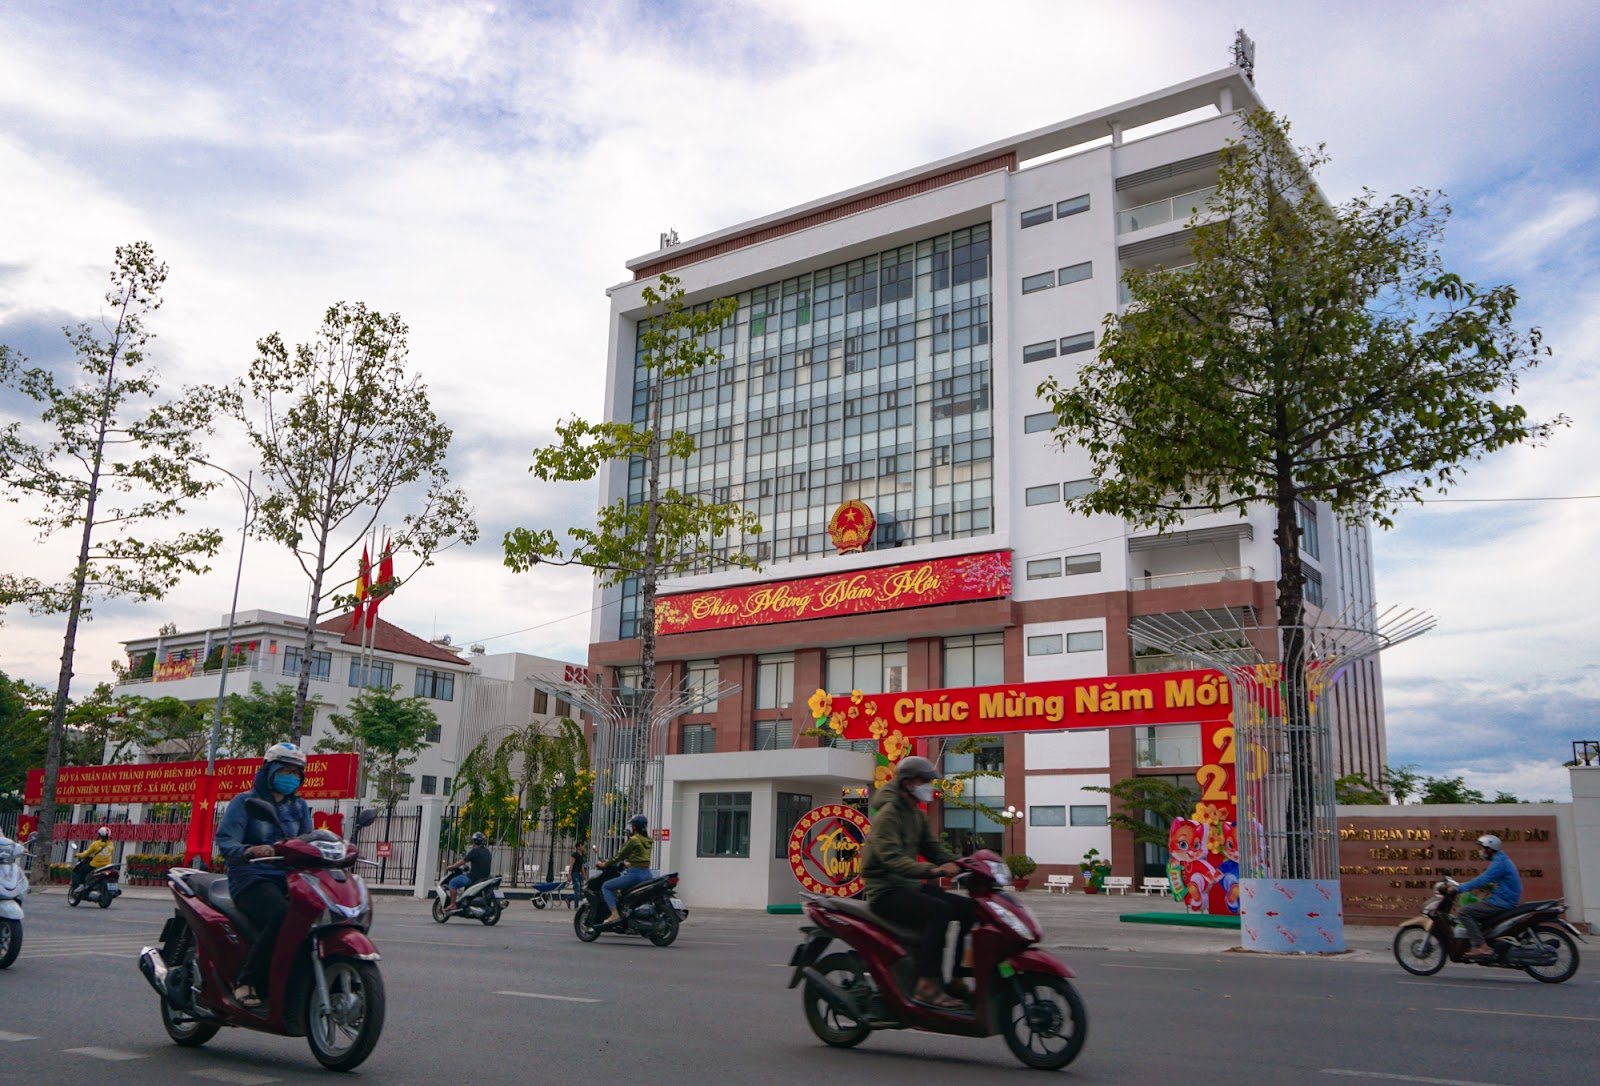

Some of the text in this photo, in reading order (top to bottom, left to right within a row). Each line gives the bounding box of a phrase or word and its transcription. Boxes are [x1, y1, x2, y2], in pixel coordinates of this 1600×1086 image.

[691, 596, 739, 619] Chúc
[811, 574, 876, 612] Năm
[877, 565, 942, 602] Mới
[893, 674, 1229, 724] Chúc Mừng Năm Mới
[63, 785, 75, 796] LỢI
[76, 783, 99, 796] NHIỆM
[102, 785, 112, 795] VỤ
[112, 784, 131, 794] KINH
[132, 781, 144, 793] TẾ
[178, 778, 196, 793] QUỐ
[240, 780, 253, 790] AN
[302, 777, 324, 788] 2023
[70, 771, 79, 781] VÀ
[80, 771, 100, 782] NHÂN
[102, 770, 118, 781] DÂN
[119, 769, 144, 780] THÀNH
[146, 766, 163, 779] PHỐ
[164, 766, 184, 778] BIÊN
[218, 764, 235, 776] SỨC
[238, 766, 252, 775] THI
